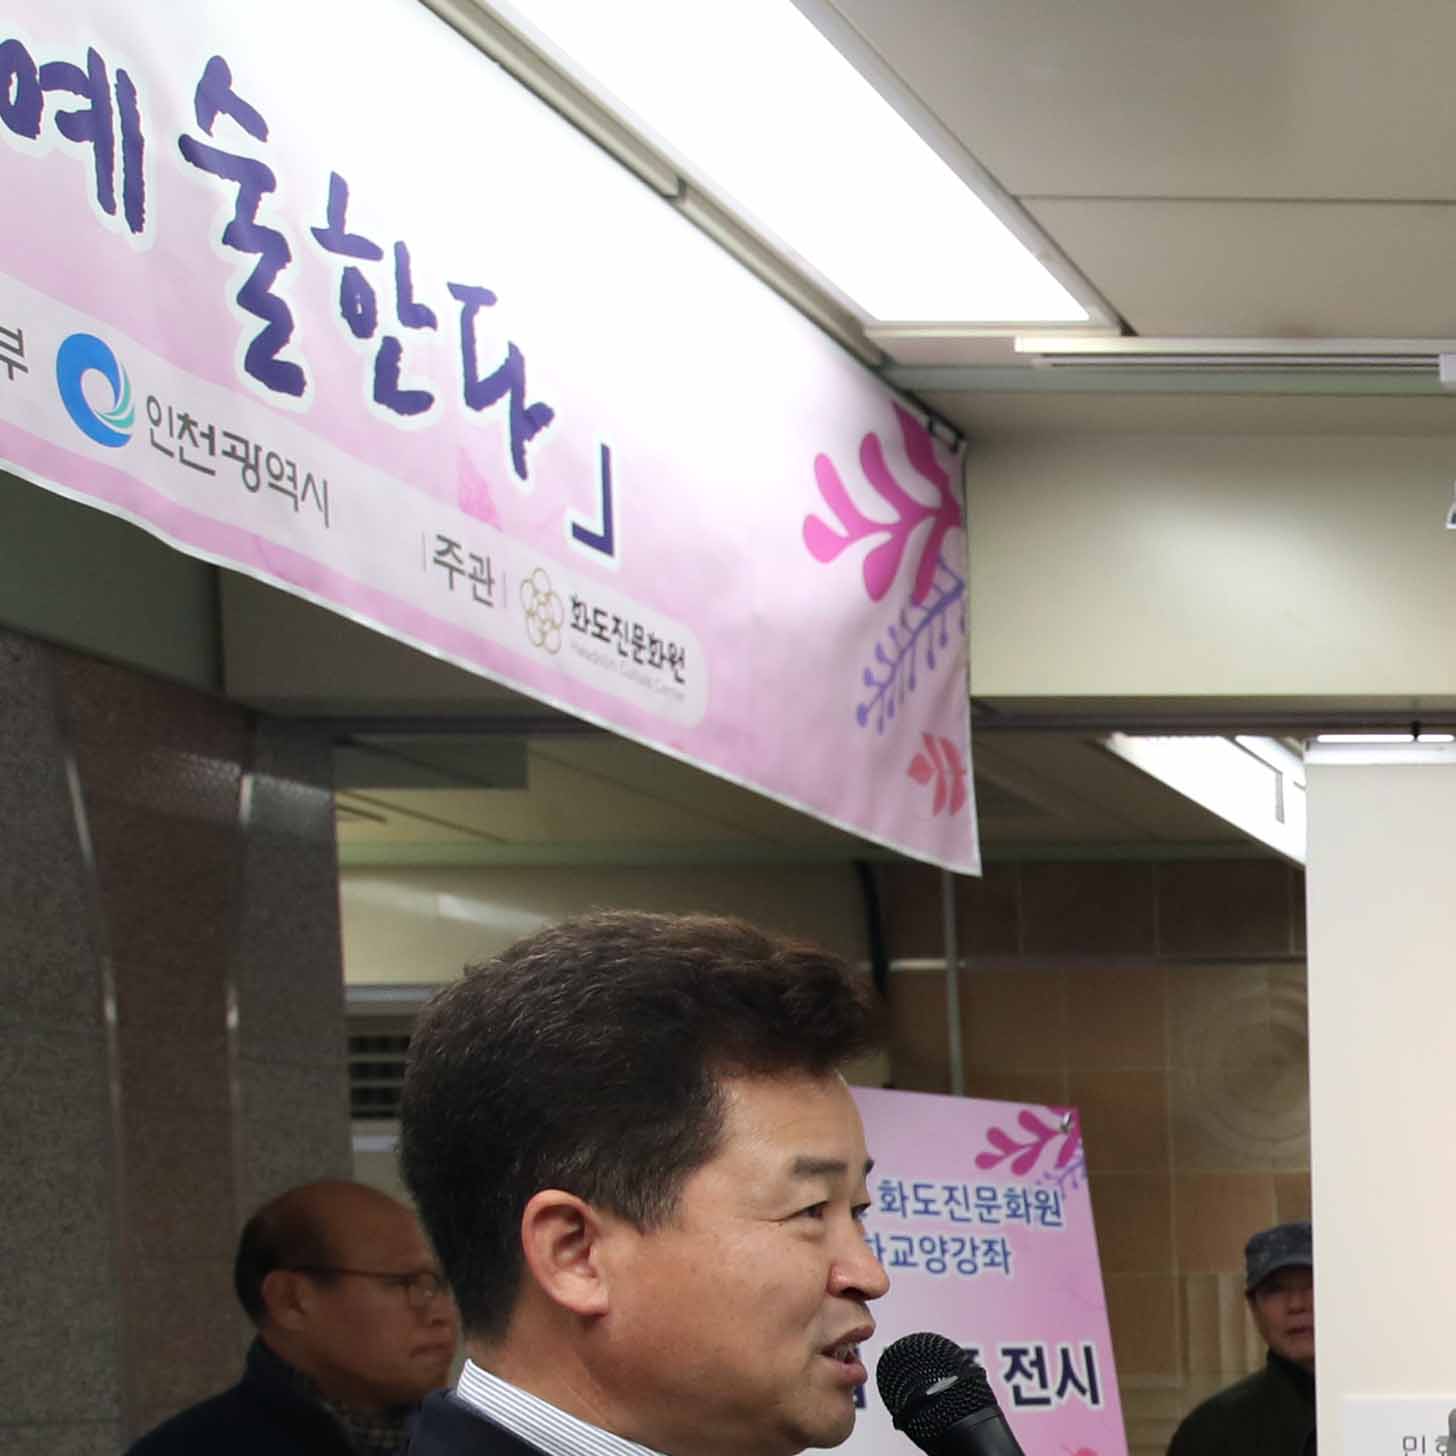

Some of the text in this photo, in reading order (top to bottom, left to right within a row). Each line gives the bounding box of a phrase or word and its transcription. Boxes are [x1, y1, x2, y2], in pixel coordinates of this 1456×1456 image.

[146, 395, 330, 529] 인천광역시
[432, 533, 496, 609] 주관
[570, 593, 686, 686] 화도진문화원
[877, 1178, 1064, 1228] 화도진문화원
[1000, 1344, 1101, 1407] 전시
